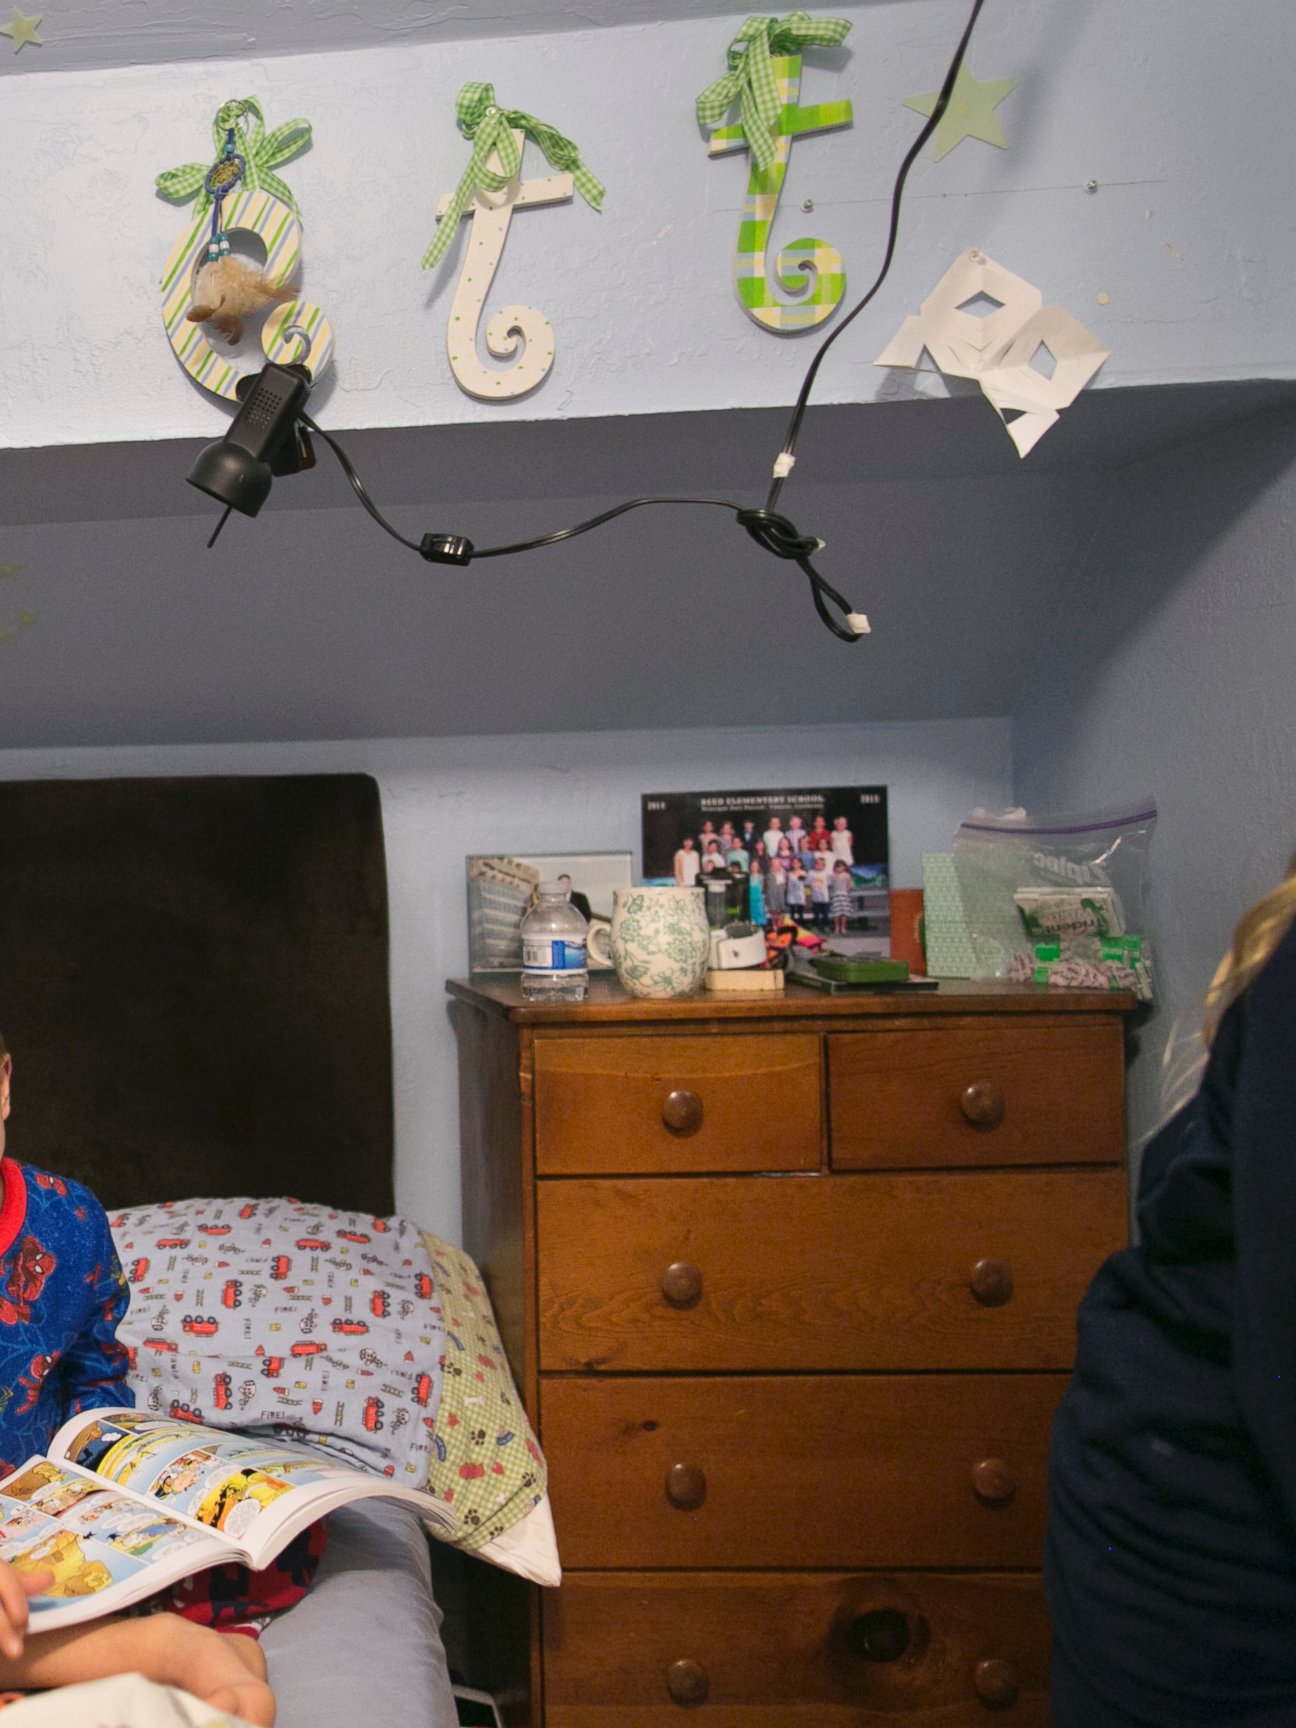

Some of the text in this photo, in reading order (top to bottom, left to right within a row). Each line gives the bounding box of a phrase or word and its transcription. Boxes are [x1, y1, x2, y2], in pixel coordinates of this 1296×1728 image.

[786, 794, 825, 804] SCHOOL
[244, 1318, 253, 1340] FIRE!
[261, 1411, 286, 1420] FIRE!
